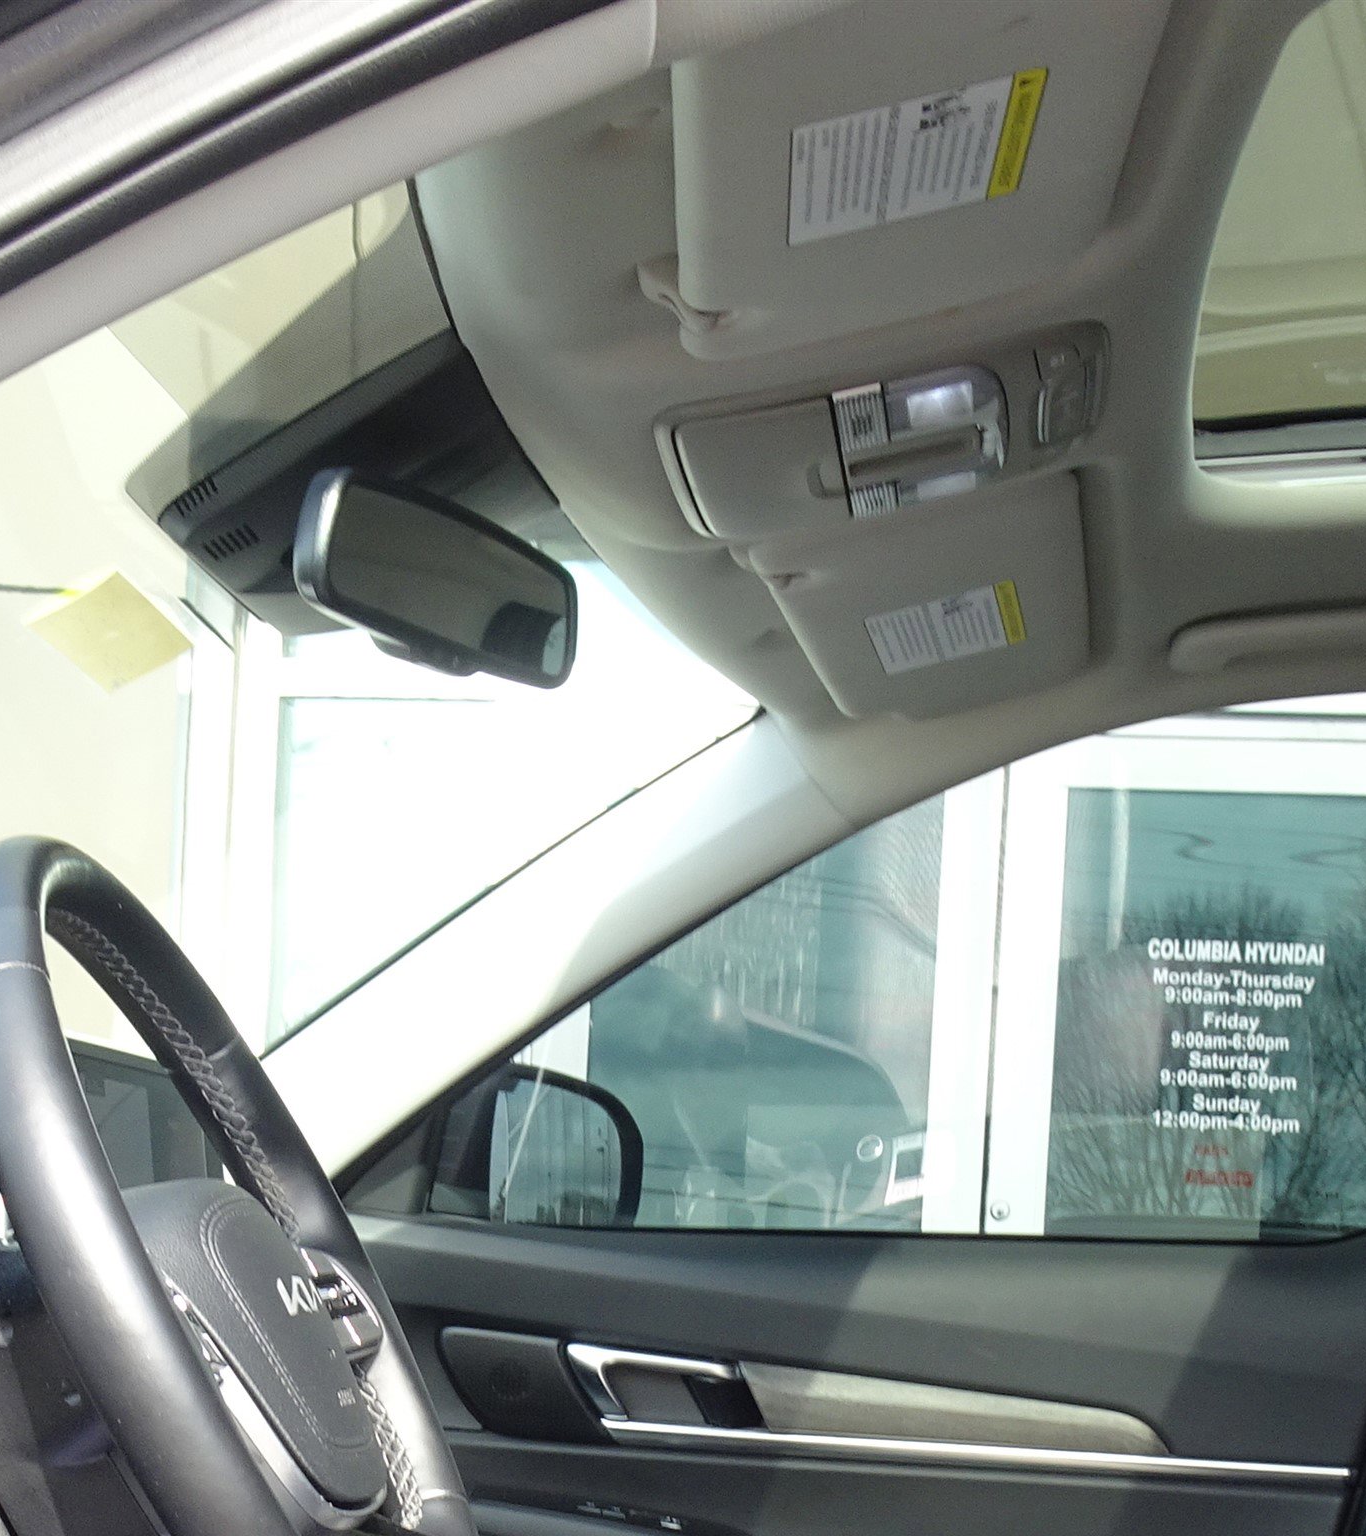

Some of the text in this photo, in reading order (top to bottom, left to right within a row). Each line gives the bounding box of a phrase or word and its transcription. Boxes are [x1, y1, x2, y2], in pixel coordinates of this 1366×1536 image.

[1148, 937, 1326, 966] COLUMBIA HYUNDAI
[1153, 967, 1316, 995] Monday-Thursday
[1164, 985, 1303, 1011] 9:00am-8:00pm
[1202, 1010, 1261, 1033] Friday
[1188, 1050, 1270, 1073] Saturday
[1192, 1092, 1261, 1116] Sunday
